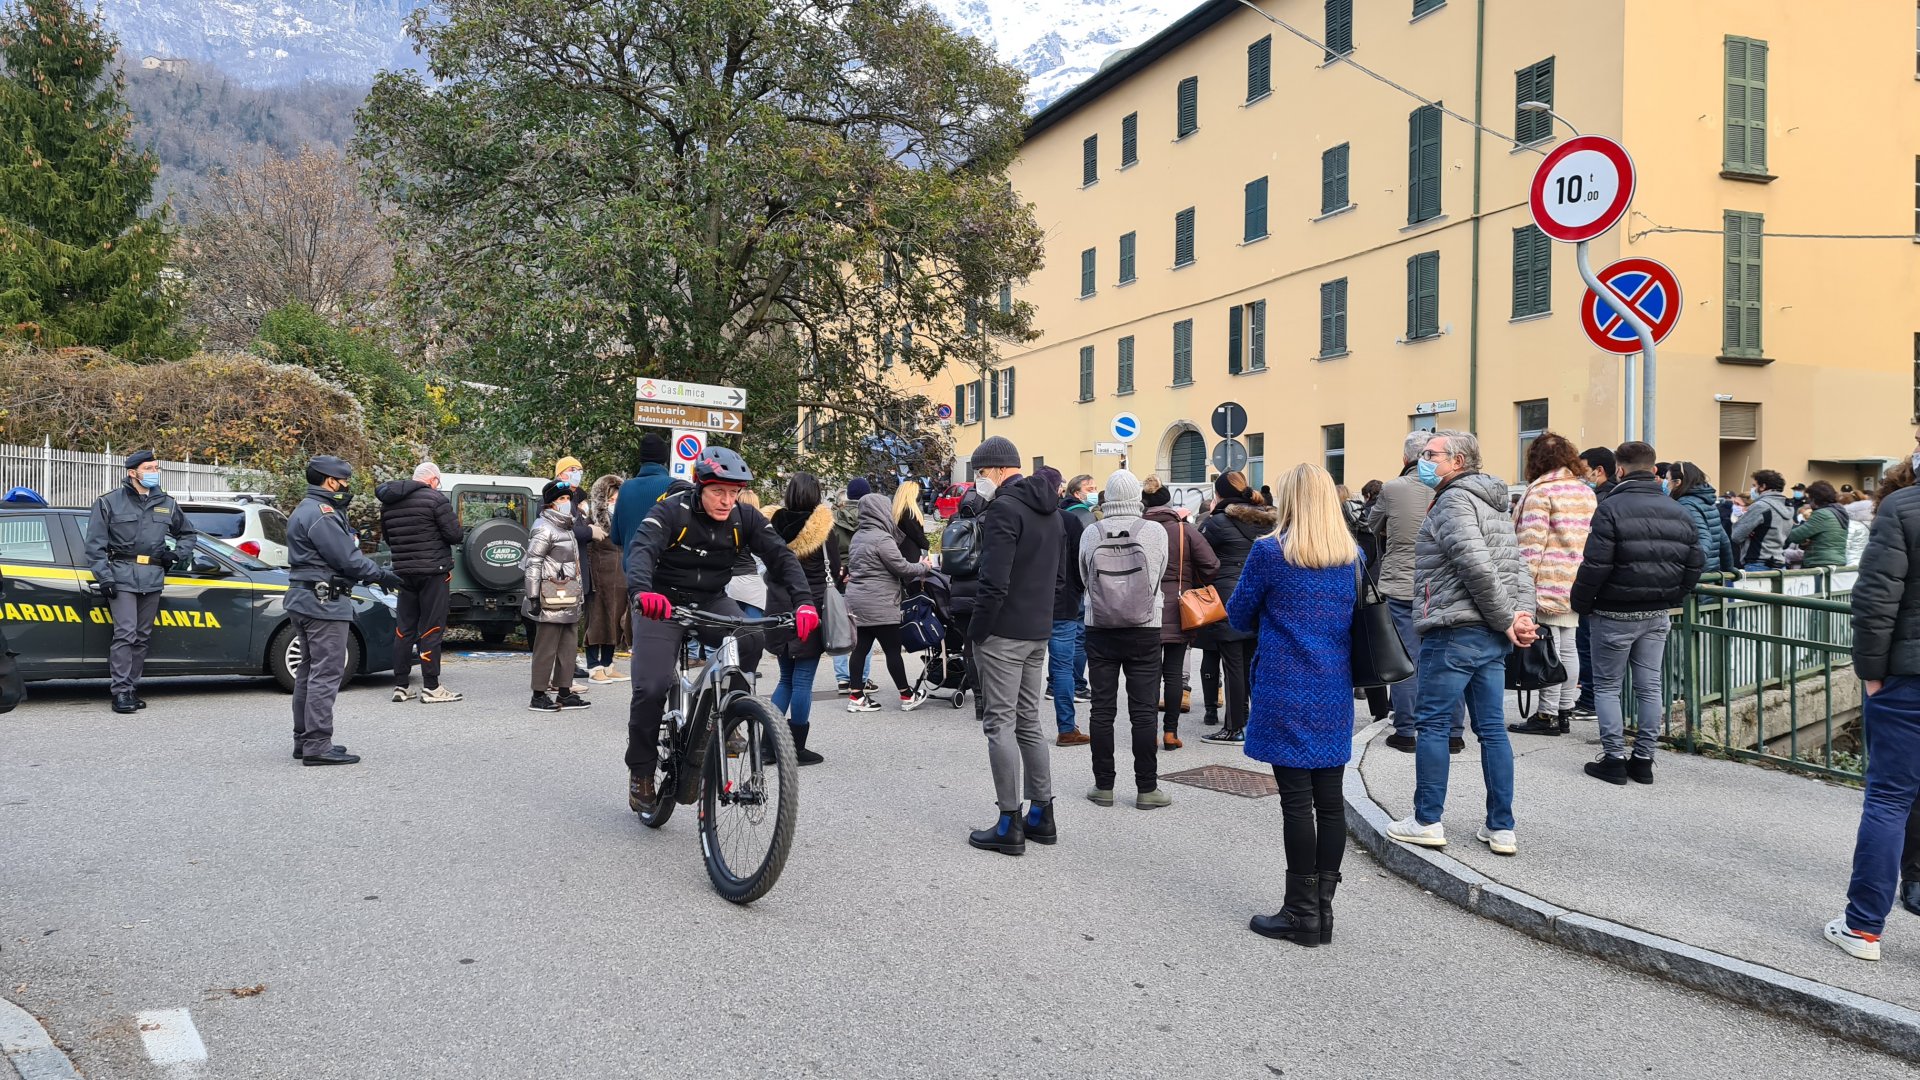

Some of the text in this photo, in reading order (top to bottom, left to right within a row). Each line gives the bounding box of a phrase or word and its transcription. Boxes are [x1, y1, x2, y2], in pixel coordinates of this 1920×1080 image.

[1556, 175, 1582, 205] 10
[661, 384, 705, 398] CasAmica
[638, 405, 686, 415] santuario
[637, 415, 707, 427] Madonna della Rovinata
[0, 602, 82, 623] ARDIA
[89, 607, 113, 624] di
